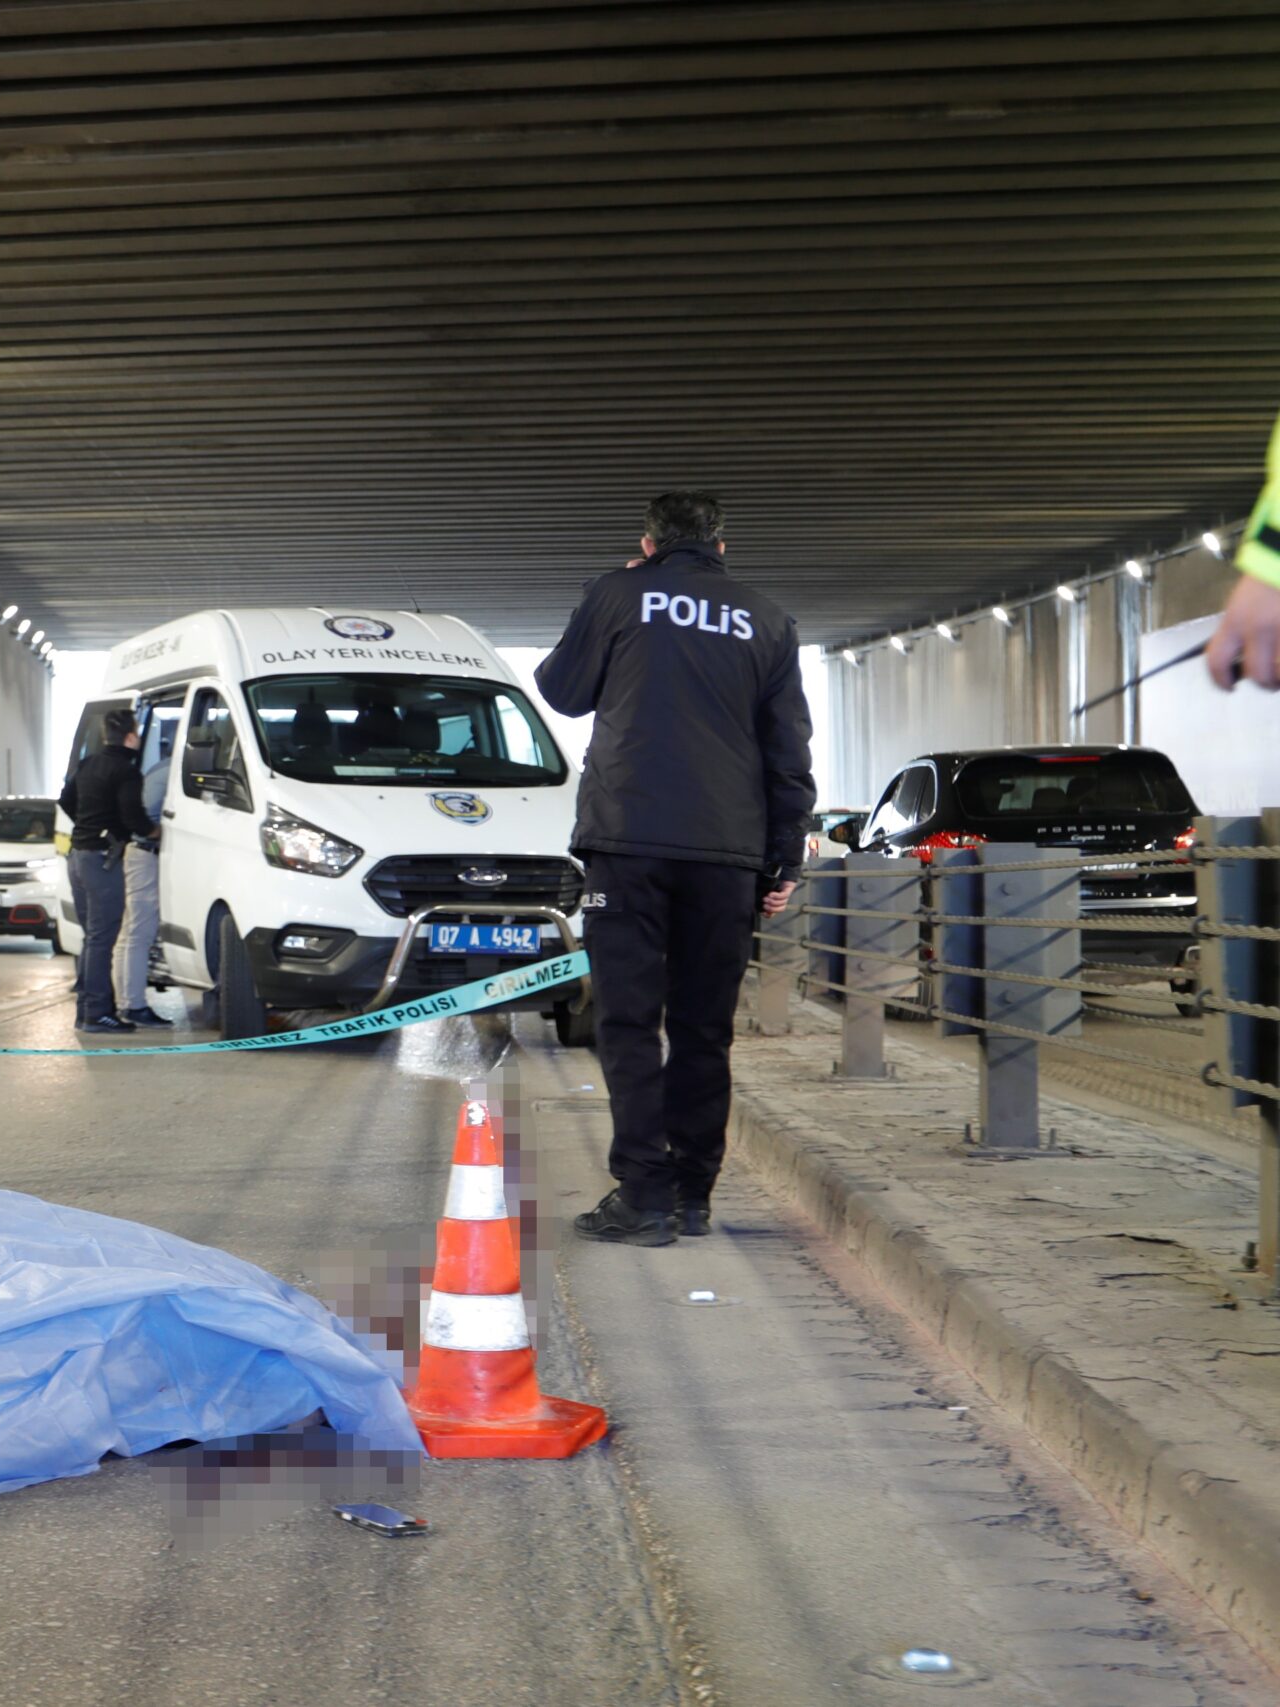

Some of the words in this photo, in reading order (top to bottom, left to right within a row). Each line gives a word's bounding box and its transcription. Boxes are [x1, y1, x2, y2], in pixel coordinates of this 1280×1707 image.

[262, 649, 317, 664] OLAY
[438, 926, 460, 945] 07
[470, 927, 480, 945] A
